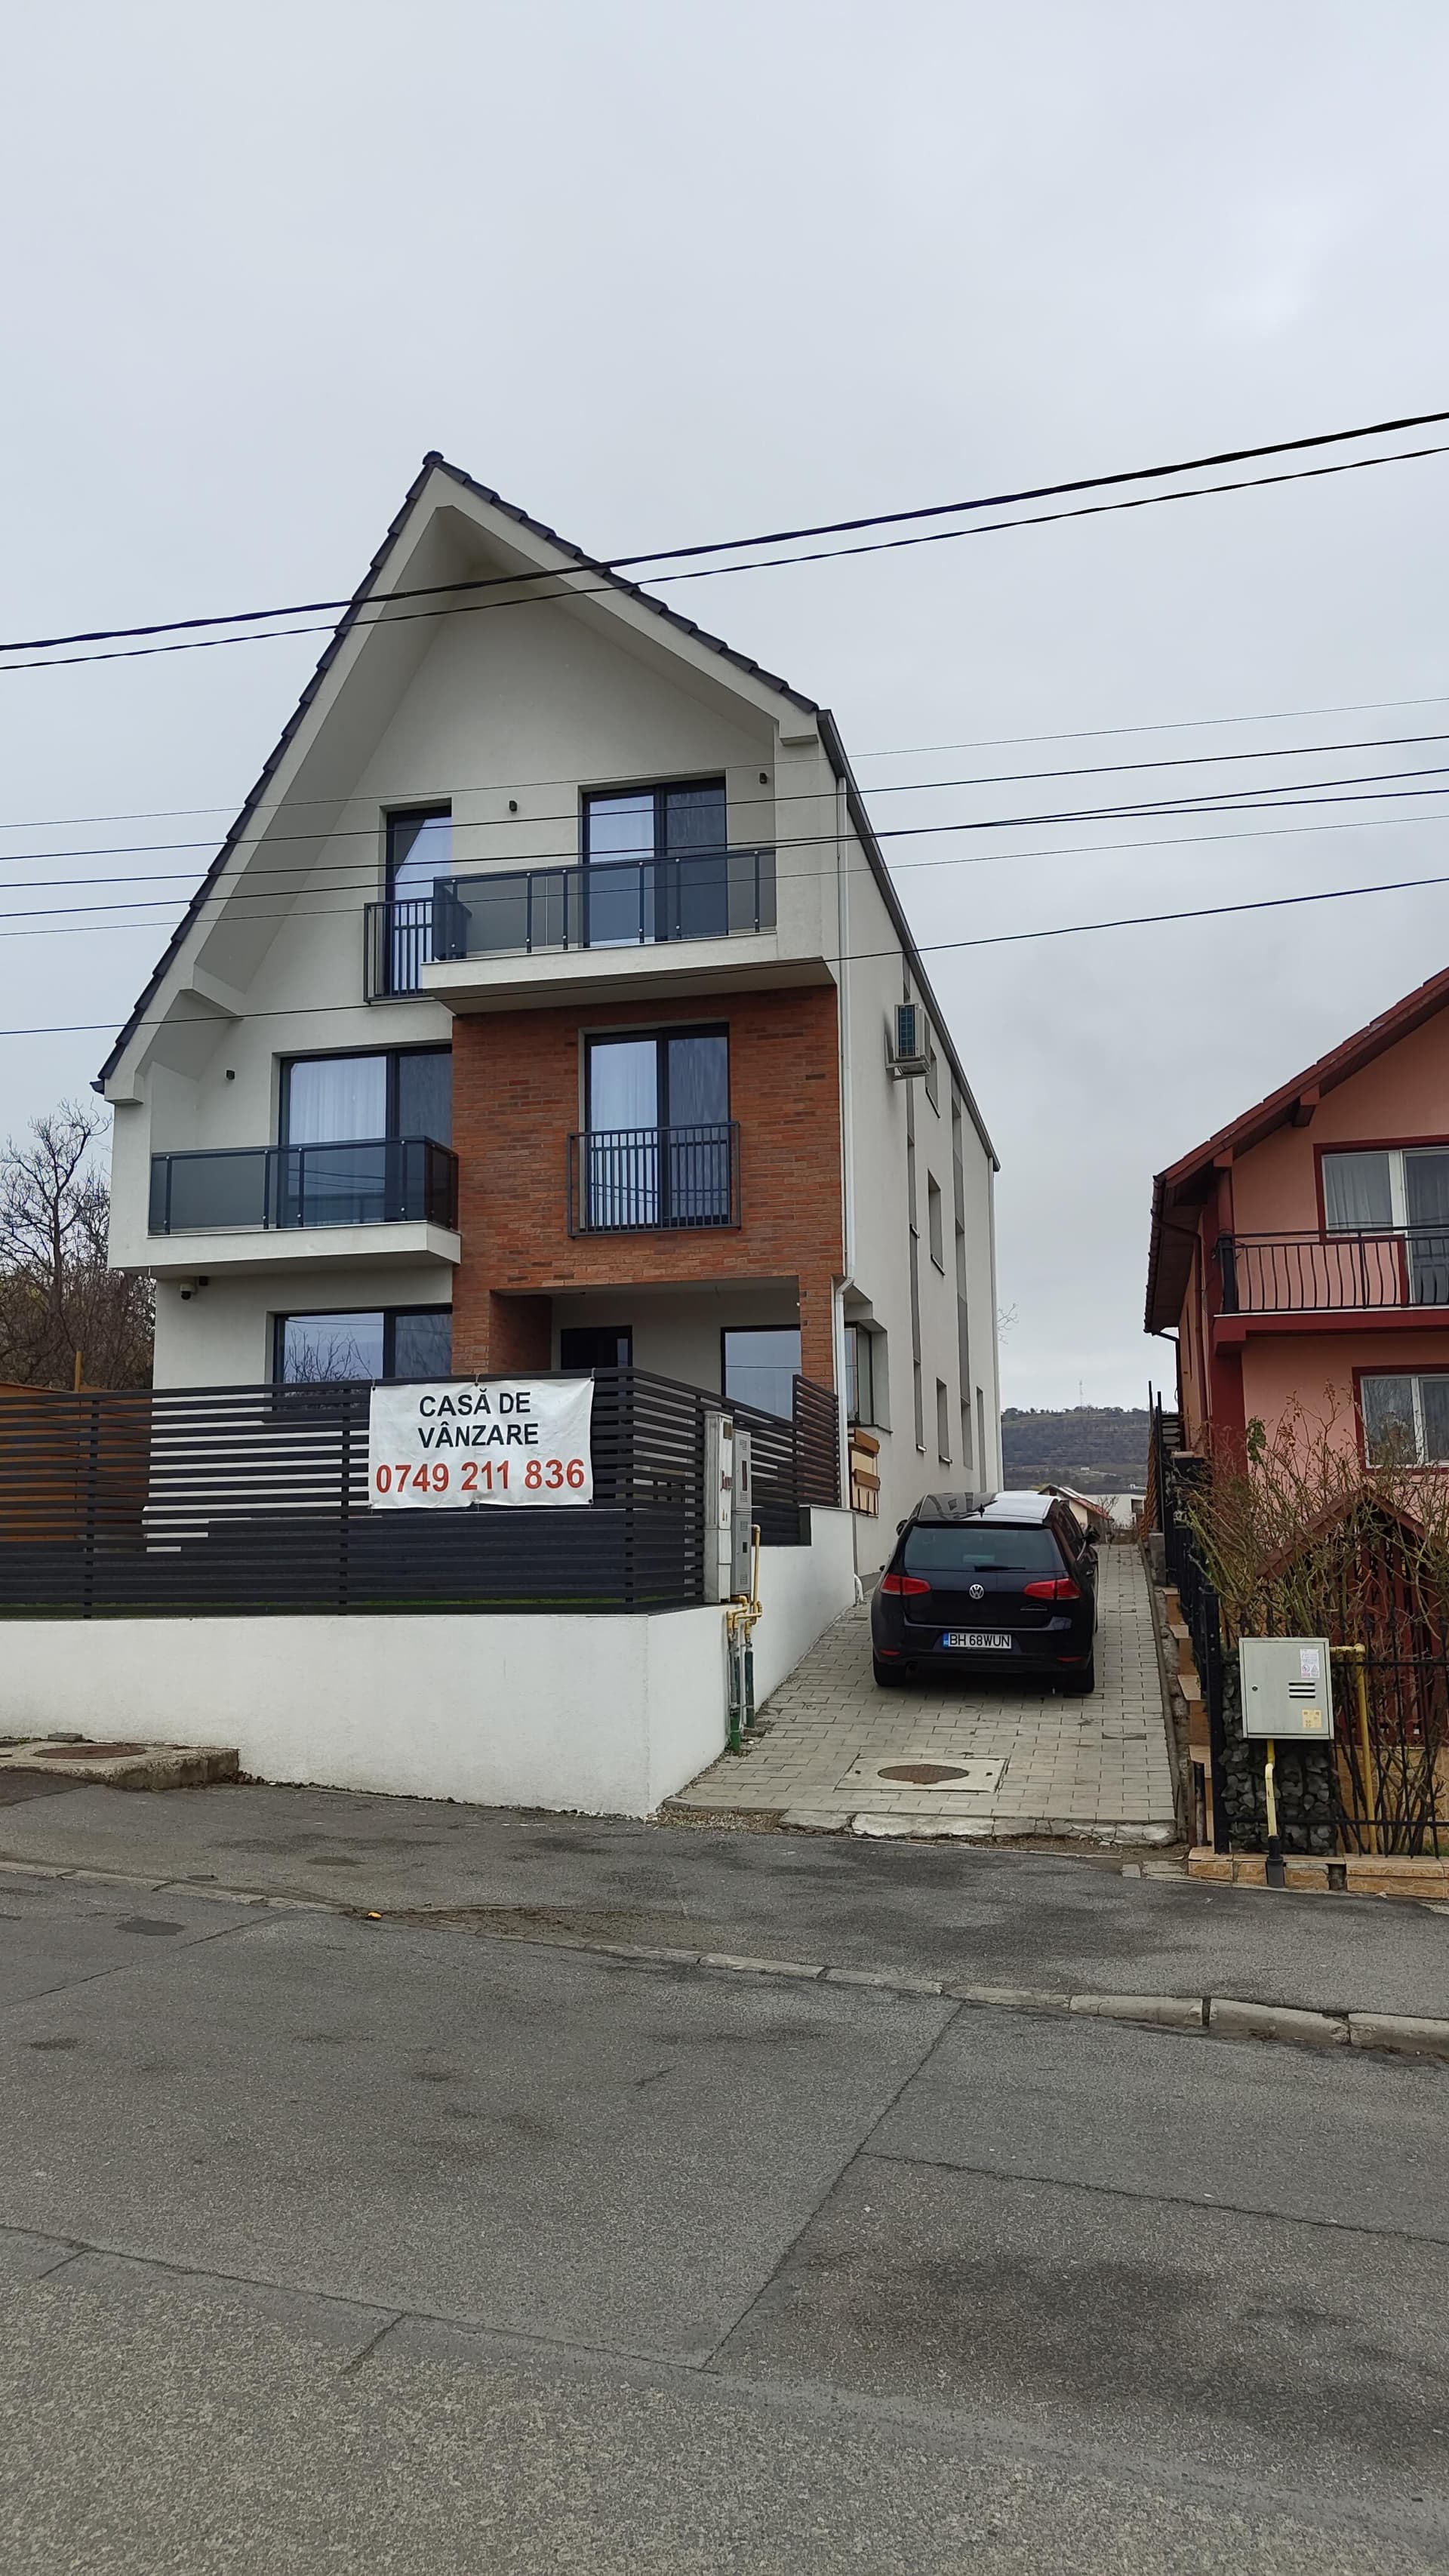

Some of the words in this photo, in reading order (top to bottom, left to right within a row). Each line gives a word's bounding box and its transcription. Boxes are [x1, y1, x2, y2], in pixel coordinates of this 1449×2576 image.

[419, 1388, 491, 1417] CASĂ
[500, 1392, 531, 1414] DE
[417, 1421, 539, 1448] VÂNZARE
[376, 1463, 449, 1494] 0749
[461, 1460, 509, 1491] 211
[525, 1458, 584, 1490] 836
[949, 1634, 967, 1645] BH
